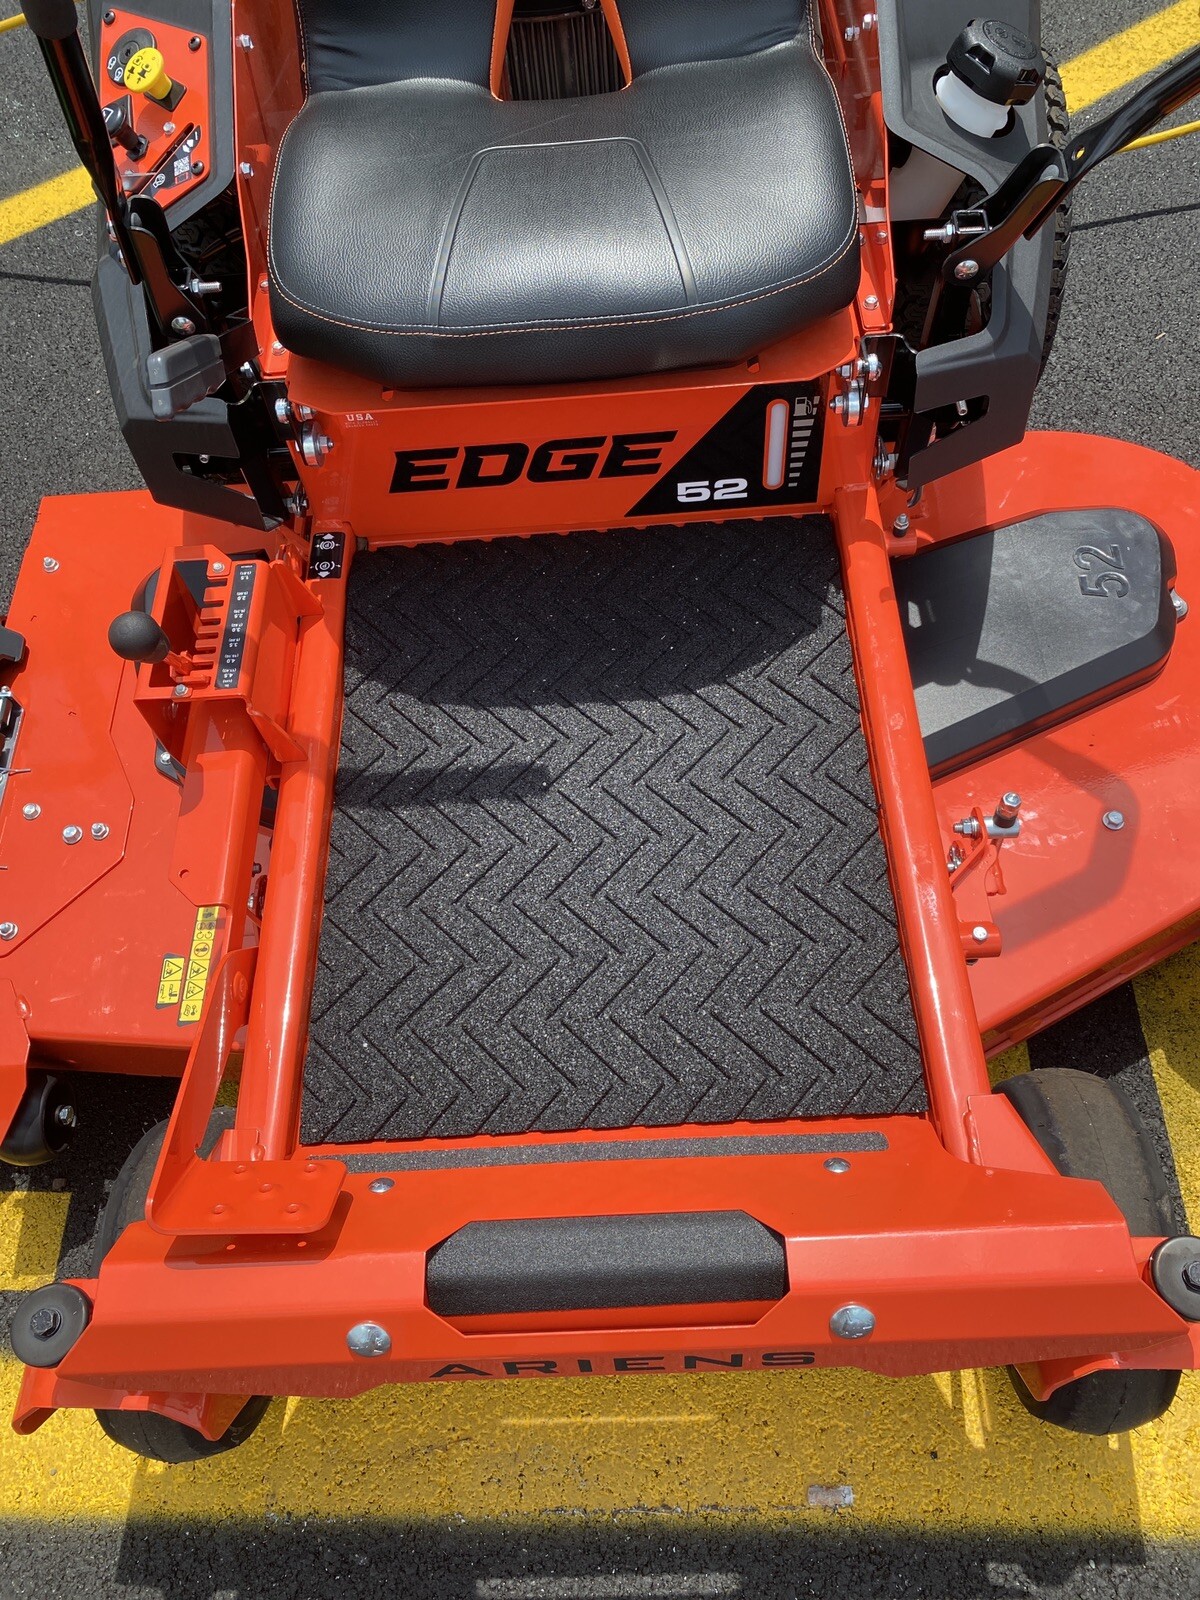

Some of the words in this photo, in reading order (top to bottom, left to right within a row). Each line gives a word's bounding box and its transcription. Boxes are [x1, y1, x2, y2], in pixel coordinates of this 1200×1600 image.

[345, 413, 374, 422] USA
[388, 429, 678, 494] EDGE
[676, 478, 748, 503] 52
[1073, 544, 1130, 598] 52
[429, 1351, 816, 1379] ARIENS
